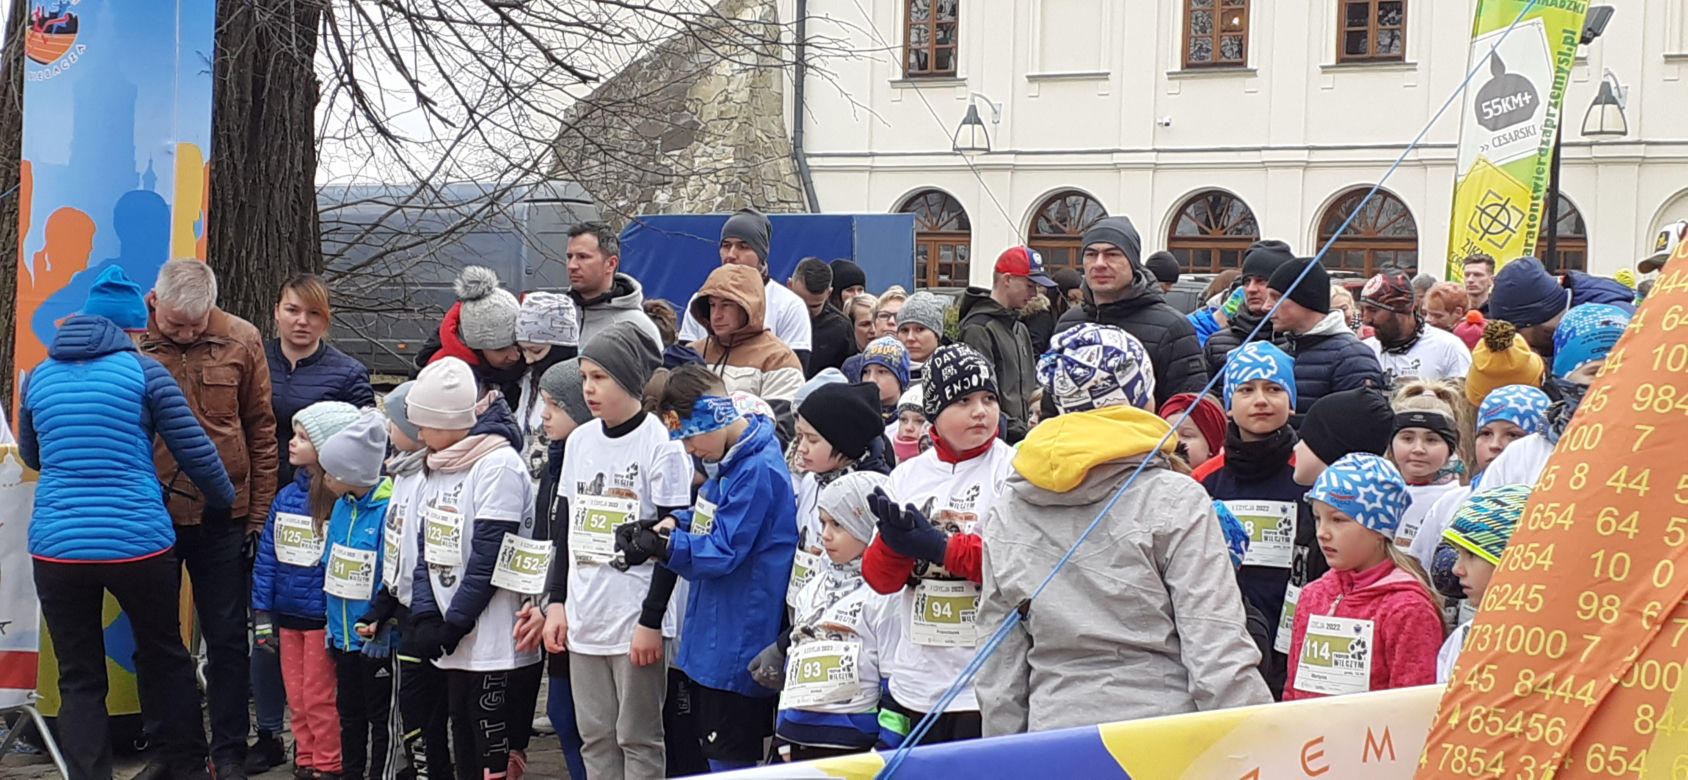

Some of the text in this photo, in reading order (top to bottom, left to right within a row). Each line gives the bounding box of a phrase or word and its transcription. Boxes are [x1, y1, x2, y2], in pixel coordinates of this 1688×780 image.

[1481, 91, 1532, 120] 55KM+
[1491, 124, 1537, 148] CESARSKI
[1631, 424, 1656, 453] 7
[1568, 462, 1590, 491] 8
[1605, 465, 1652, 497] 44
[1256, 504, 1270, 512] 2022
[427, 525, 442, 541] 123
[589, 514, 608, 529] 52
[1527, 502, 1576, 532] 654
[1596, 507, 1640, 540] 64
[1663, 516, 1688, 547] 5
[283, 529, 302, 544] 125
[334, 560, 346, 576] 91
[515, 555, 540, 571] 152
[1499, 543, 1676, 588] 7854 10 0
[931, 601, 953, 618] 94
[1576, 590, 1622, 624] 98
[1326, 622, 1341, 631] 2022
[1305, 639, 1331, 660] 114
[1579, 633, 1602, 663] 7
[803, 662, 822, 679] 93
[1464, 663, 1499, 692] 45
[1513, 668, 1598, 707] 8444
[1467, 704, 1567, 747] 65456
[1438, 743, 1506, 779] 7854
[1586, 743, 1650, 780] 654
